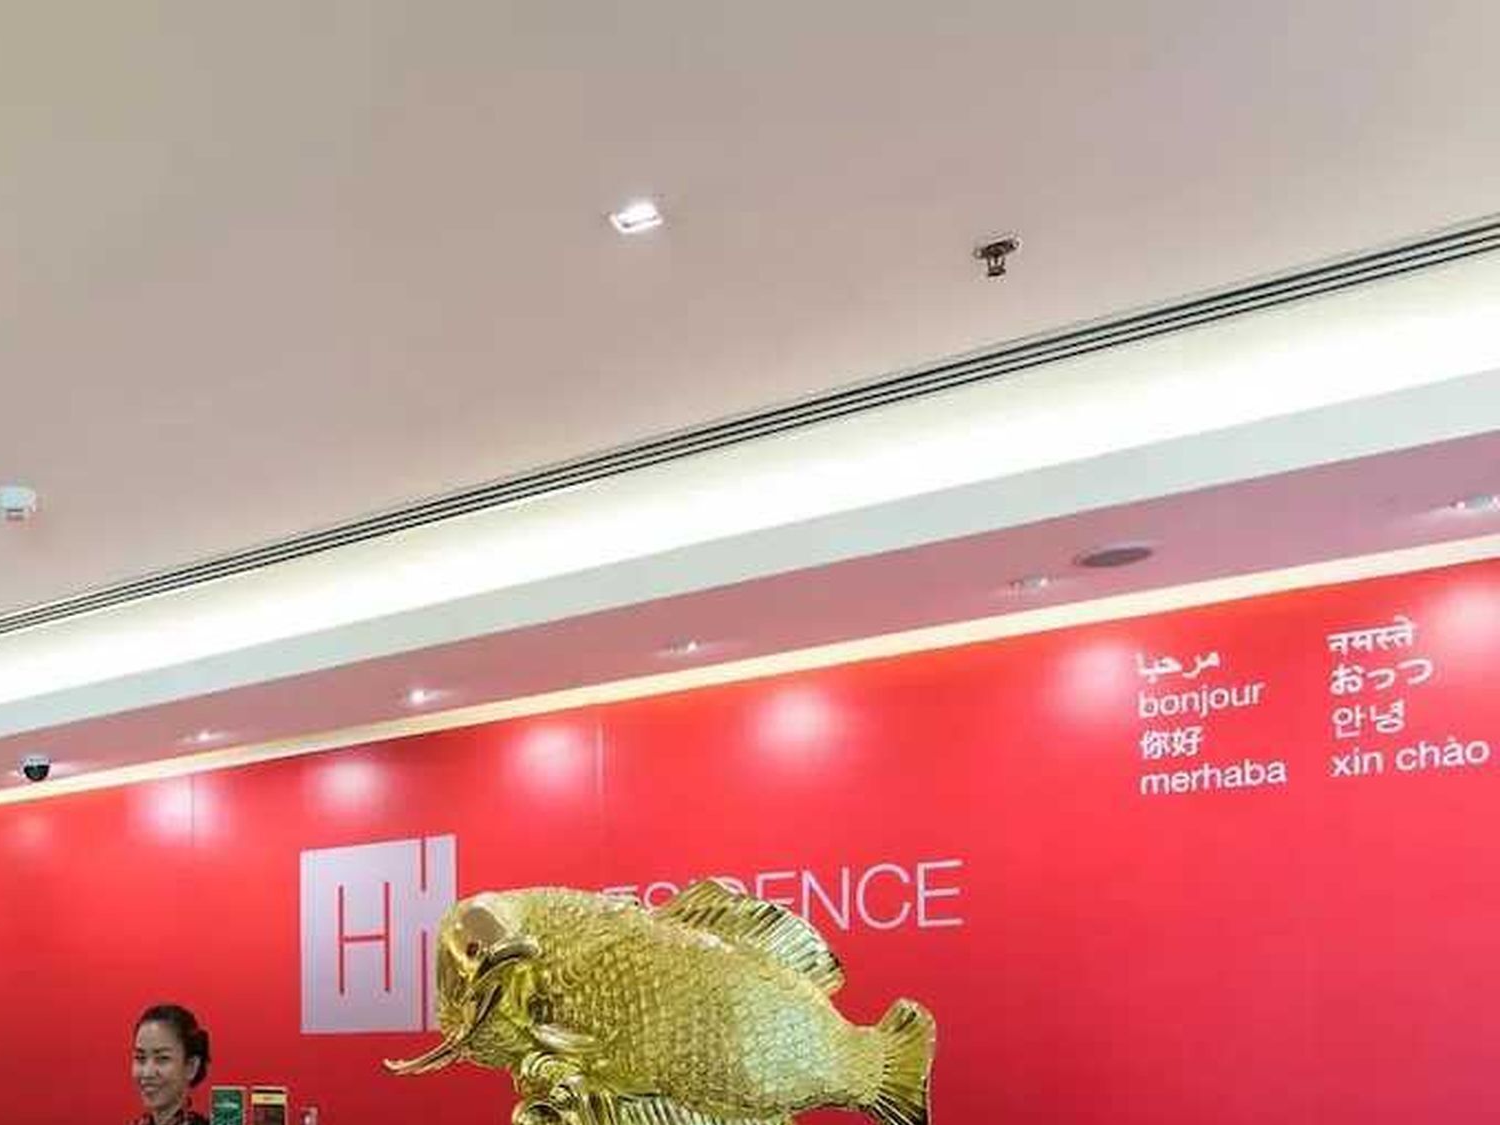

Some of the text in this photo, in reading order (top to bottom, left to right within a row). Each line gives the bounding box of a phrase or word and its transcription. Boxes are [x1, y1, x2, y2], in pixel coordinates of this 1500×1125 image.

[1327, 615, 1414, 655] नमस्ते
[1136, 651, 1221, 683] مرحبا
[1330, 657, 1434, 695] おっつ
[1139, 682, 1265, 718] bonjour
[1332, 698, 1405, 739] 안녕
[1140, 726, 1203, 760] 你好
[1141, 758, 1288, 795] merhaba
[1331, 748, 1384, 778] xin
